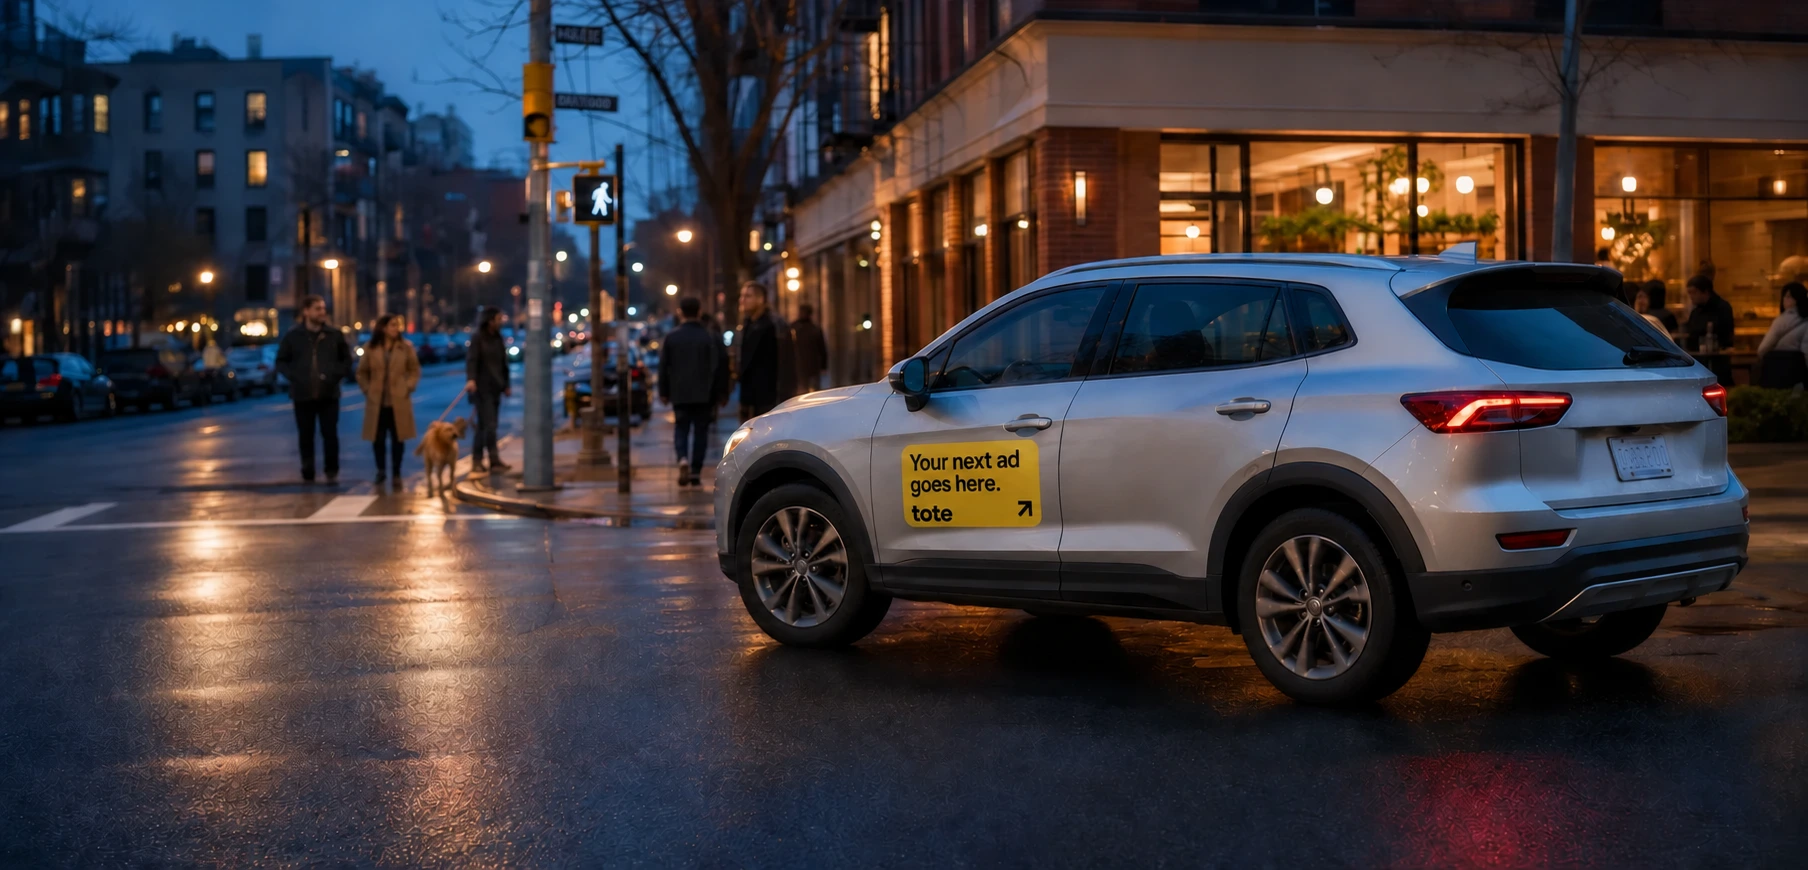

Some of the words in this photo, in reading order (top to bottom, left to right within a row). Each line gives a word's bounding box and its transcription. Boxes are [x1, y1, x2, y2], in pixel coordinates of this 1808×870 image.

[910, 453, 949, 471] Your
[952, 452, 992, 470] next
[997, 449, 1020, 468] ad
[910, 479, 951, 498] goes
[955, 474, 1001, 492] here.
[911, 505, 953, 522] tote
